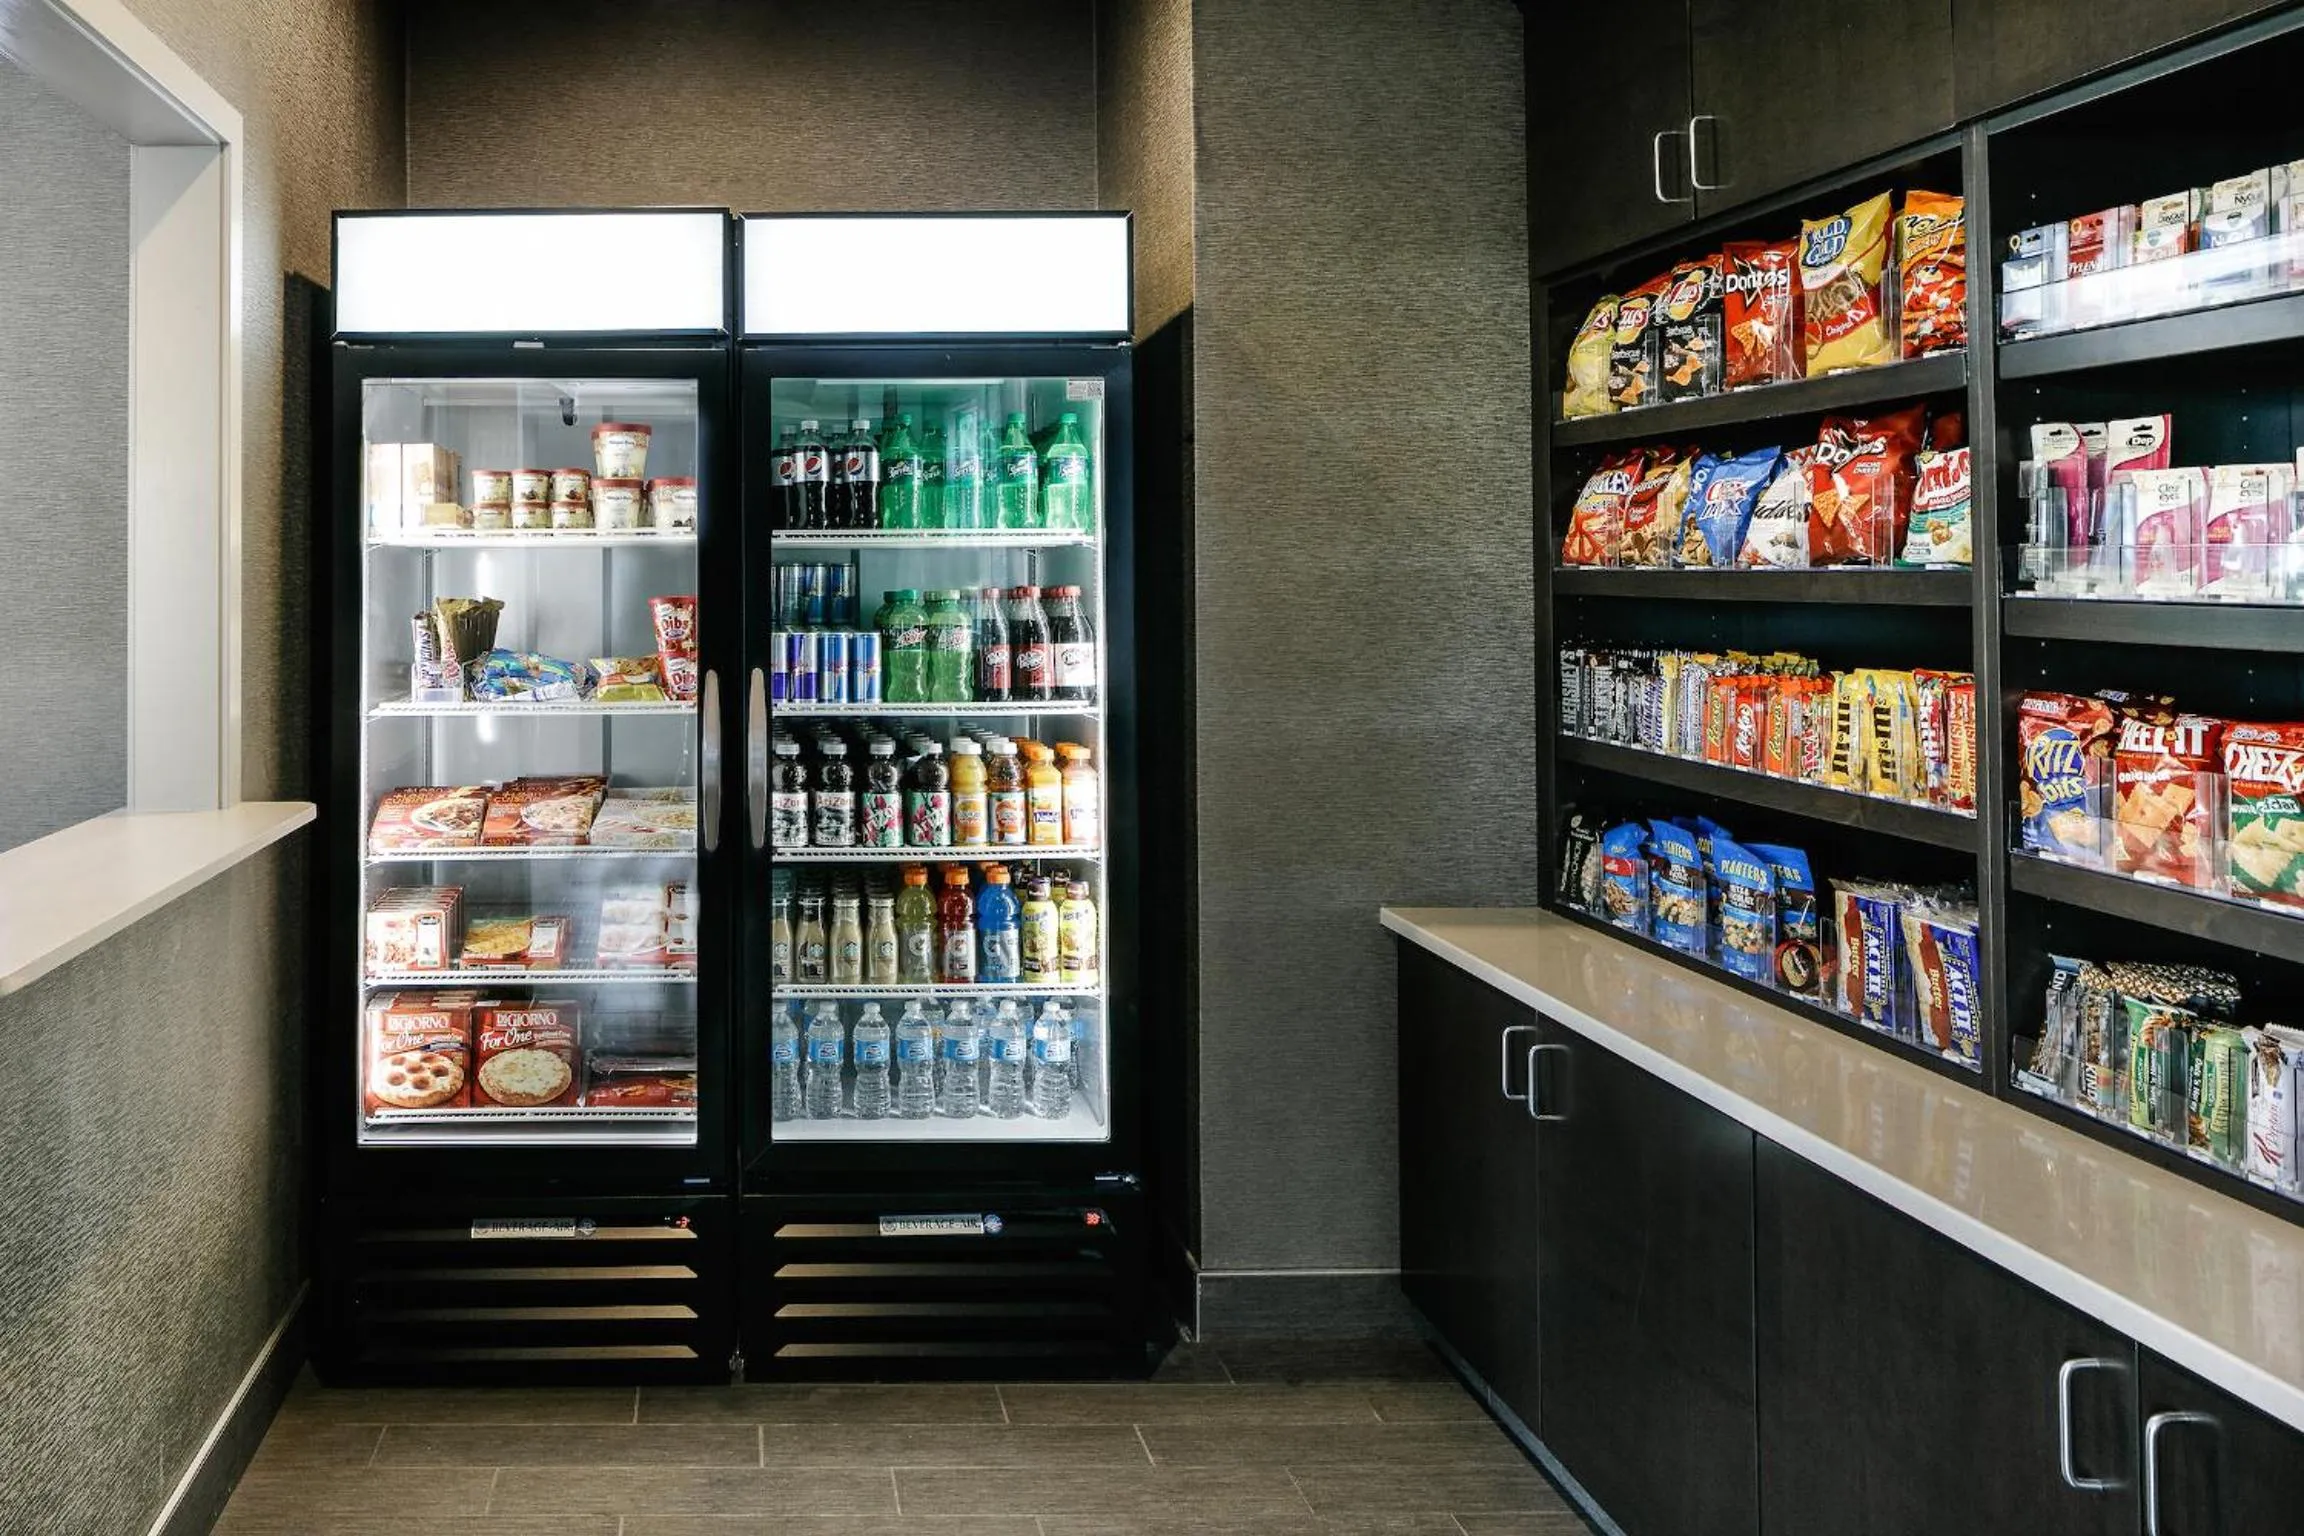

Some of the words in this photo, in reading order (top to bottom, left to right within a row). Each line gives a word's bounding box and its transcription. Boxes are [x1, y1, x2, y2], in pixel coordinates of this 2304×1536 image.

[1726, 269, 1789, 293] Doritos
[661, 616, 688, 630] Dibs
[1561, 650, 1577, 724] HERSHEY'S
[1707, 692, 1721, 748] Reese's
[1768, 703, 1782, 761] Reese's
[2027, 739, 2082, 780] RITZ
[2040, 776, 2084, 802] bits
[1720, 859, 1768, 885] PLANTERS
[1850, 937, 1861, 979] Butter
[1866, 933, 1881, 973] ACT
[1929, 968, 1942, 1010] Butter
[1949, 965, 1968, 1003] ACT
[396, 1031, 426, 1048] One
[481, 1032, 506, 1050] For
[504, 1029, 532, 1047] One
[2084, 1064, 2098, 1100] KIND
[2265, 1103, 2281, 1148] Protein
